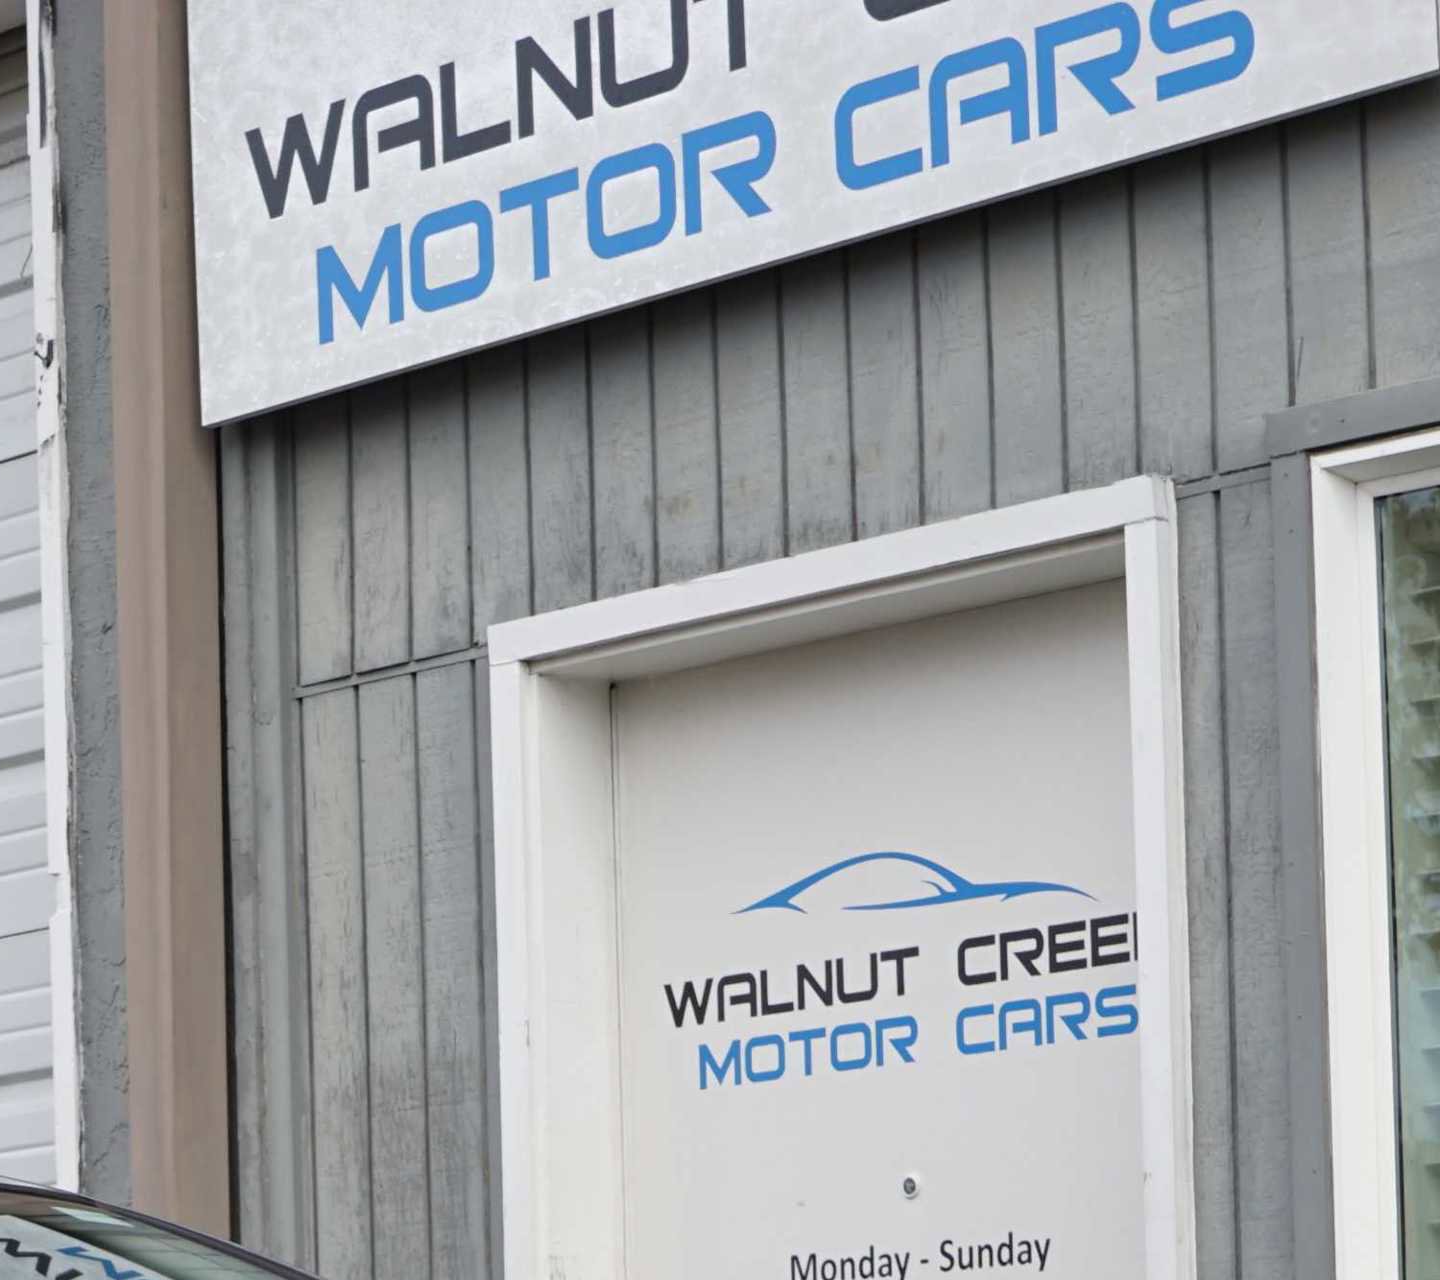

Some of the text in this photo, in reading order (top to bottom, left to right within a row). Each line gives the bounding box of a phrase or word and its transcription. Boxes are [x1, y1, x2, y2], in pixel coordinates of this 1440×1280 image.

[316, 0, 1256, 345] MOTOR CARS
[662, 911, 1138, 1029] WALNUT CREE
[697, 983, 1139, 1090] MOTOR CARS
[938, 1230, 1052, 1274] Sunday
